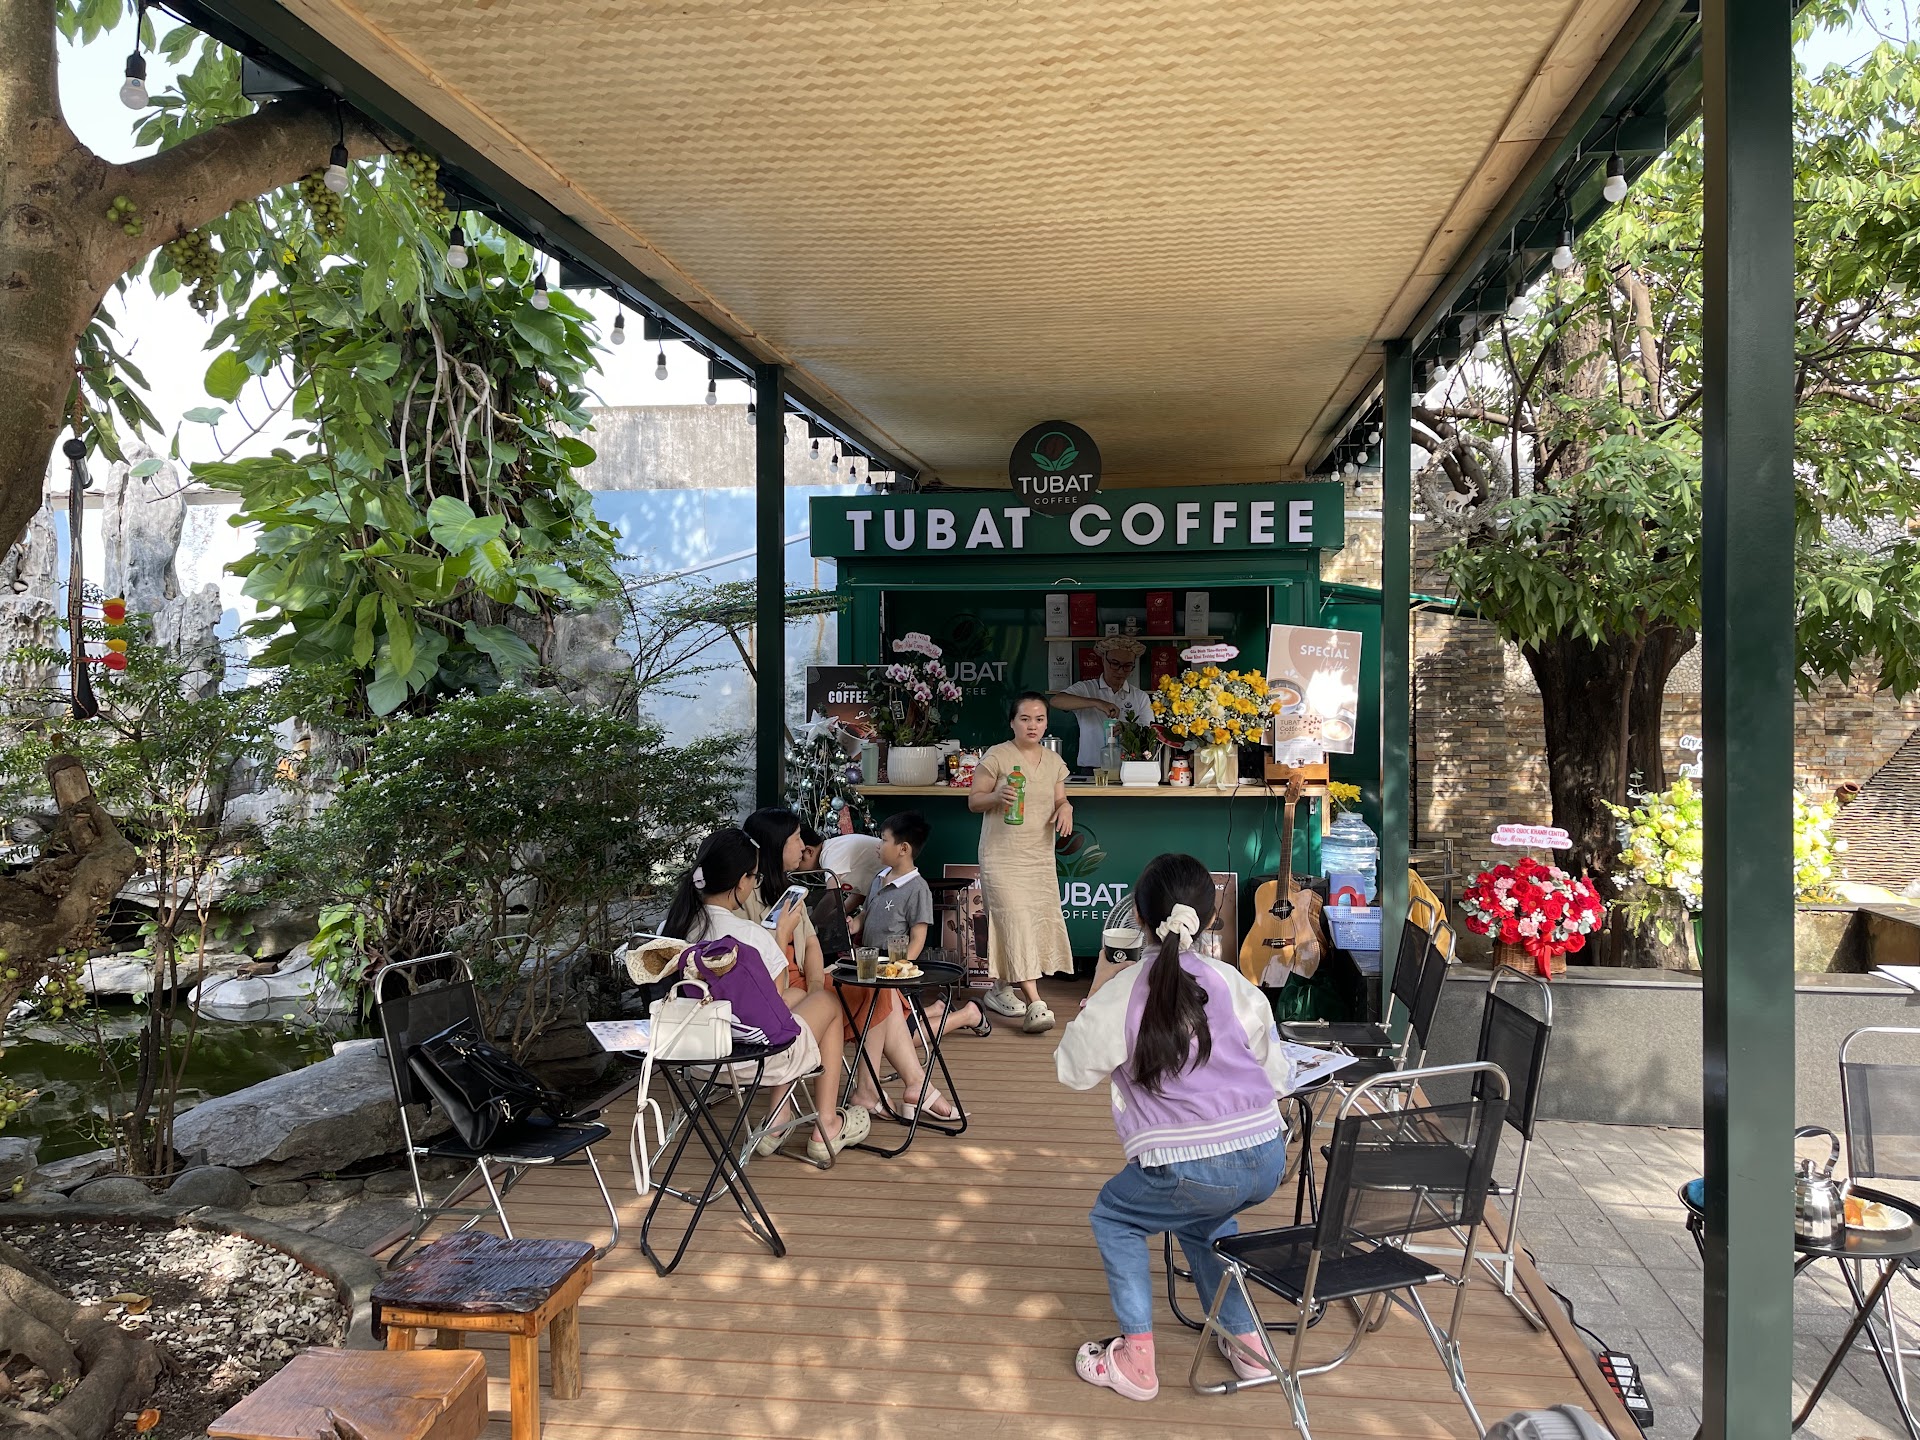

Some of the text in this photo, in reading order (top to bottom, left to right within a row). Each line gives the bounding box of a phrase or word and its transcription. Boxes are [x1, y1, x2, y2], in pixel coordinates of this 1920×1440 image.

[1018, 474, 1093, 494] TUBAT
[1034, 496, 1078, 505] COFFEE
[846, 500, 1314, 551] TUBAT COFFEE
[1300, 645, 1350, 660] SPECIAL
[948, 661, 1008, 682] UBAT
[828, 690, 869, 704] COFFEE
[1548, 830, 1566, 838] CENTER
[1060, 882, 1129, 907] UBAT
[1062, 909, 1109, 920] OFFEE
